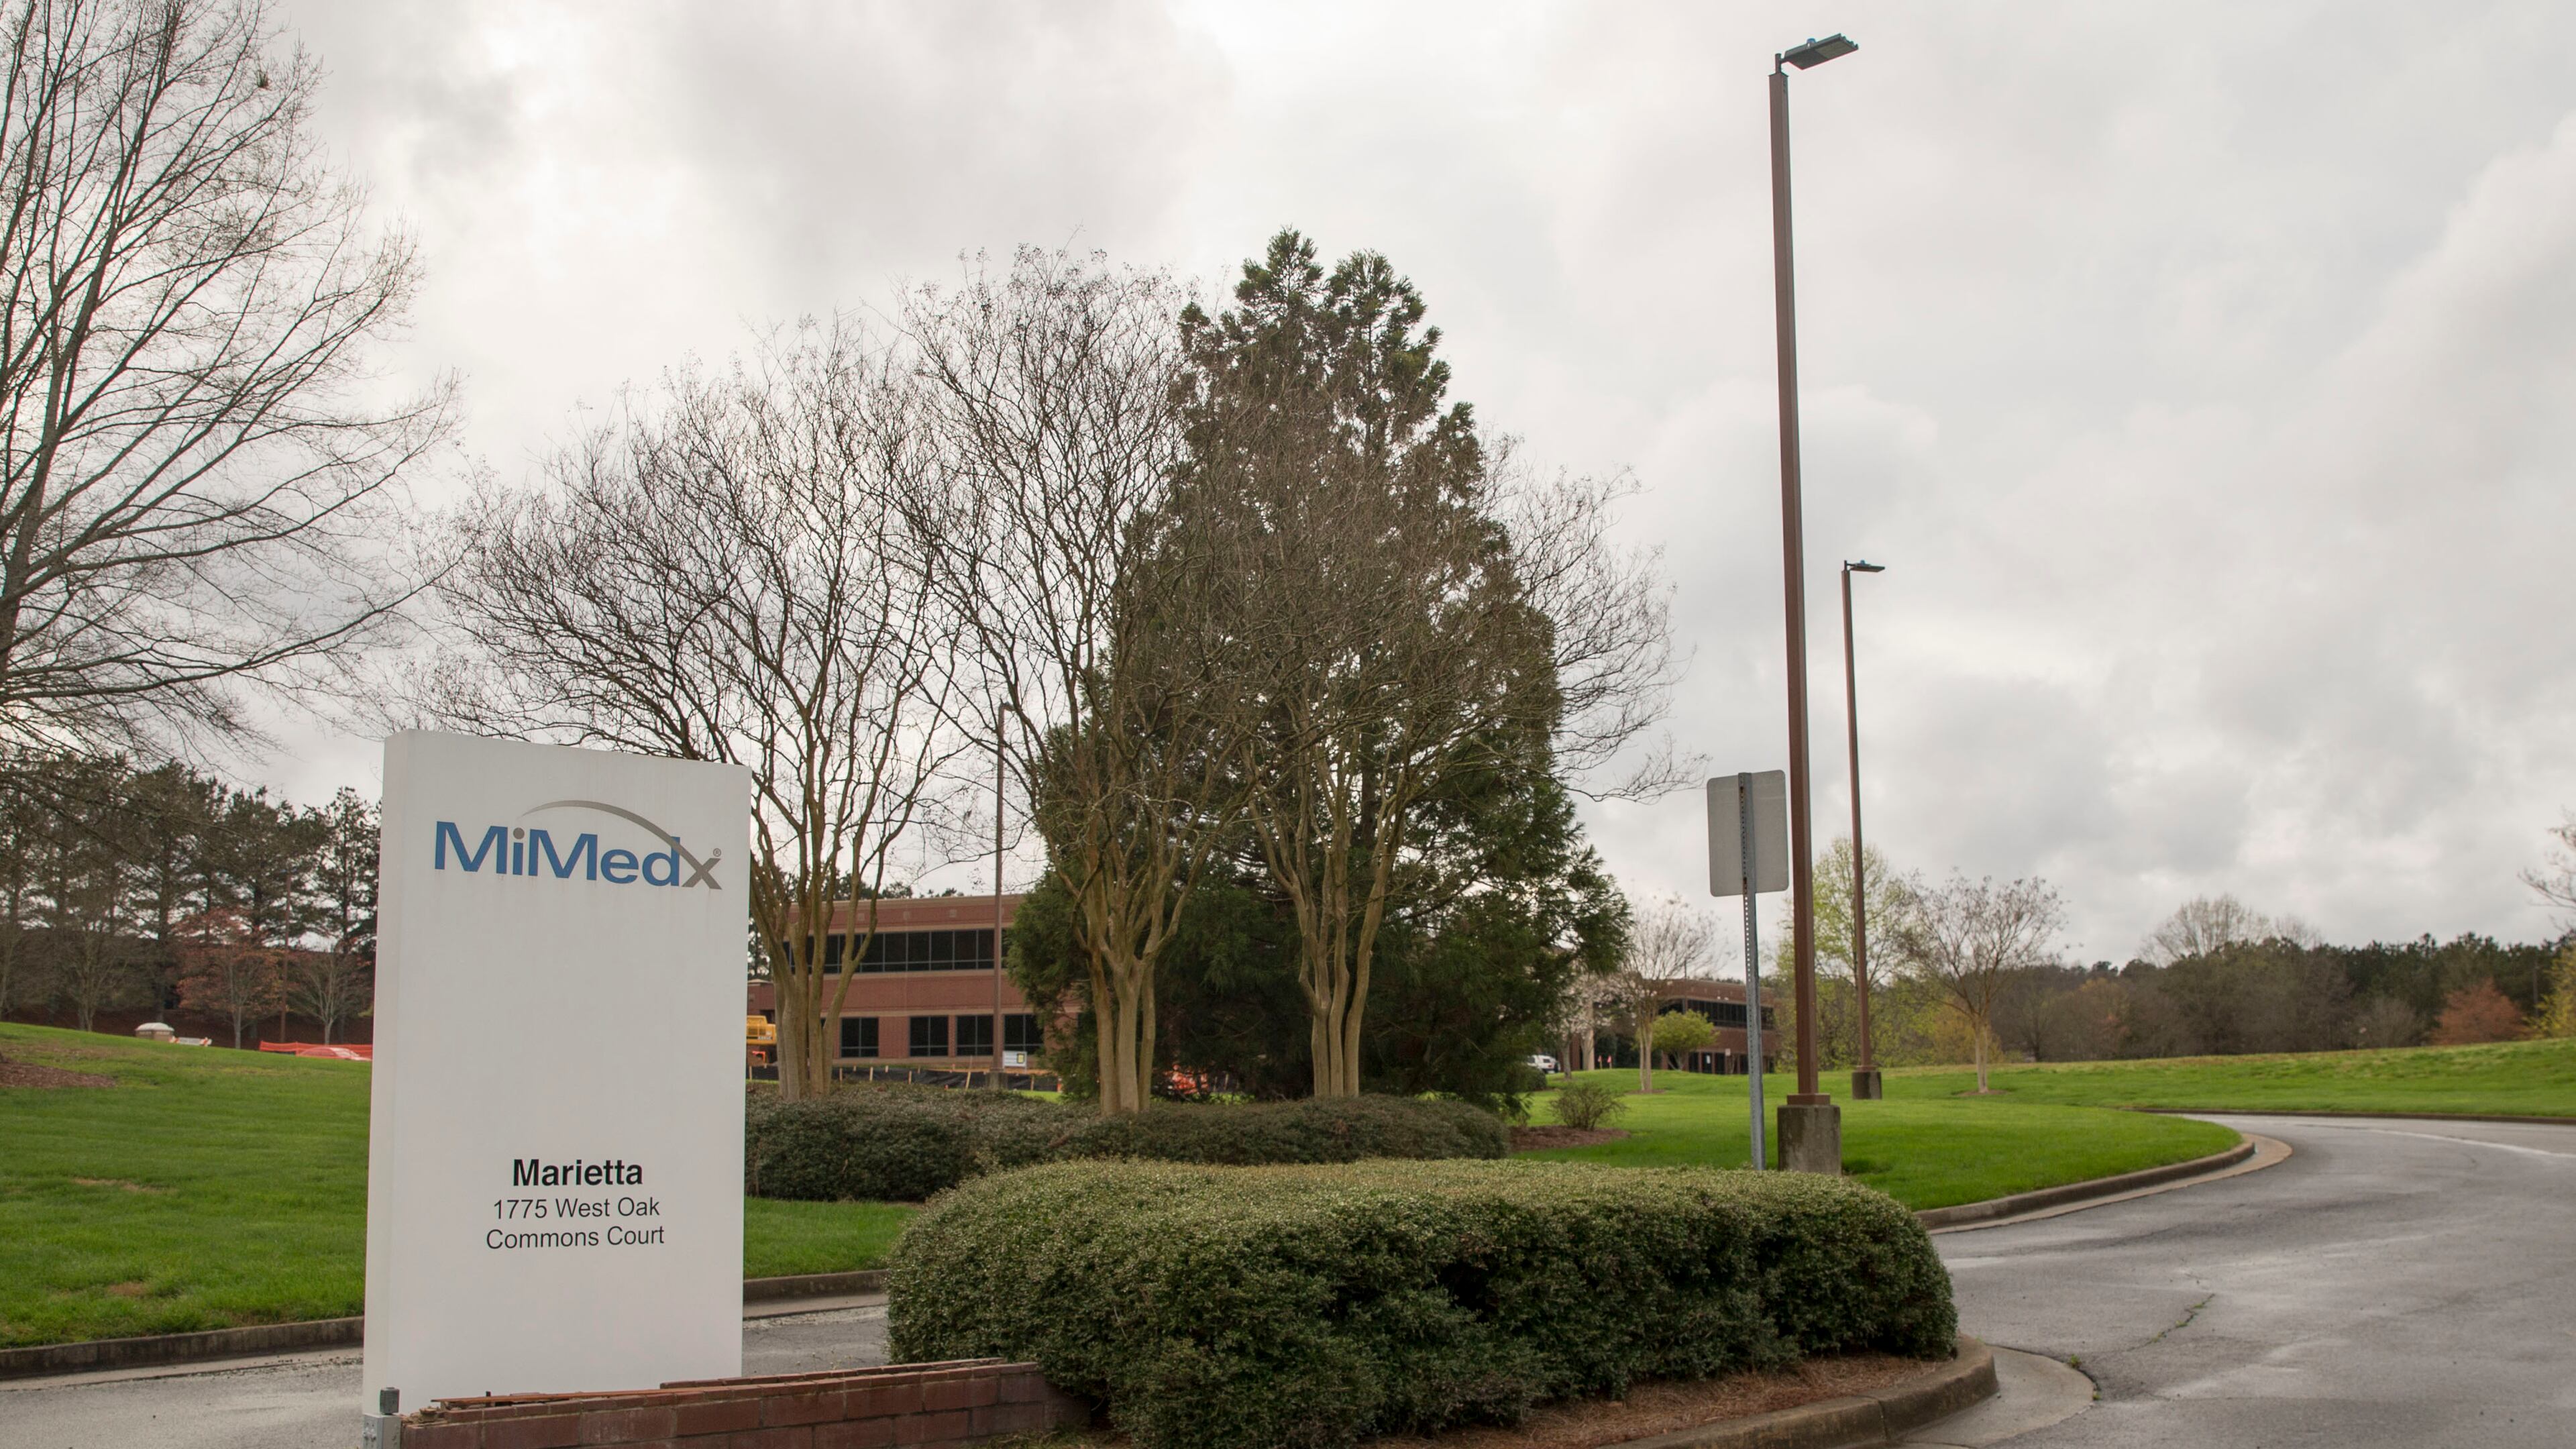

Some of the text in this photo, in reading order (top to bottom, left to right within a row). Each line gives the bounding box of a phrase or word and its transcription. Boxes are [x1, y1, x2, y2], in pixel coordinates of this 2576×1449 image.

[513, 1159, 643, 1187] Marietta
[494, 1196, 661, 1220] 1775 West Oak
[486, 1225, 665, 1250] Commons Court
